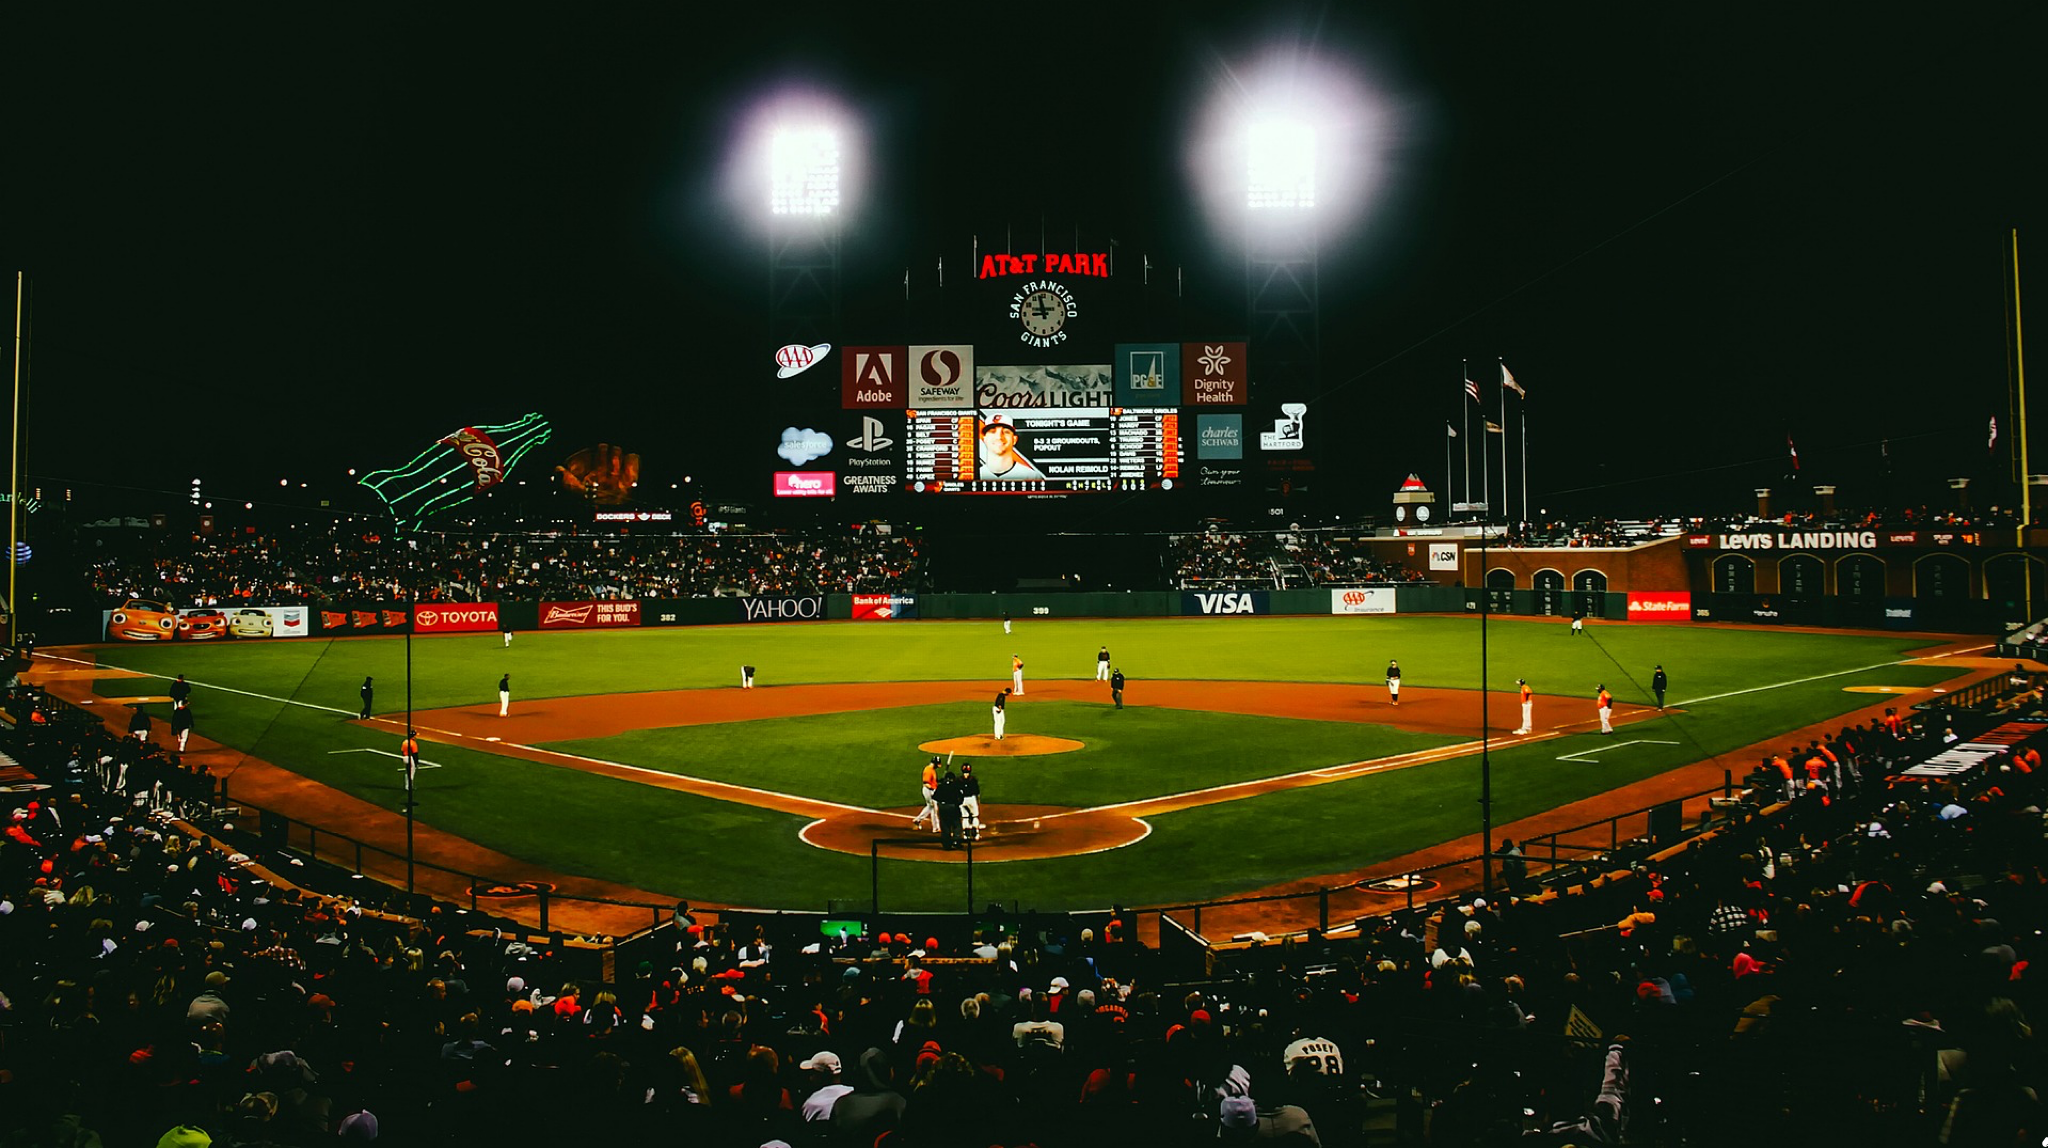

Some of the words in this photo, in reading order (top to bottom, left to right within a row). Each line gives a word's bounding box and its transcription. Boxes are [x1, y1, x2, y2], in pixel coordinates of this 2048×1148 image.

[979, 254, 1038, 279] AT&T
[1045, 253, 1108, 278] PARK
[1009, 292, 1025, 319] SAN
[1022, 280, 1078, 318] FRANCISCO
[1020, 330, 1067, 348] GIANTS
[778, 345, 812, 368] AAA
[1132, 374, 1163, 388] PG&E
[1194, 379, 1235, 392] Dignity
[856, 390, 893, 402] Adobe
[920, 387, 960, 395] SAFEWAY
[978, 383, 1048, 408] Coors
[1050, 391, 1113, 408] LIGHT
[1196, 392, 1233, 403] Health
[1025, 420, 1066, 428] TONIGHT'S
[1201, 426, 1239, 438] charles
[784, 439, 827, 449] salesforce
[1201, 439, 1239, 447] SCHWAB
[463, 443, 502, 487] Cola
[848, 458, 891, 468] PlayStation
[843, 475, 897, 485] GREATNESS
[1220, 469, 1240, 479] your
[852, 485, 888, 494] AWAITS
[1778, 532, 1877, 549] LANDING
[1440, 552, 1456, 561] CSN
[854, 597, 874, 605] Bank
[1194, 593, 1254, 614] VISA
[1342, 591, 1365, 606] AAA
[597, 604, 614, 613] THIS
[615, 603, 638, 613] BUD'S
[742, 597, 823, 621] YAHOO!
[440, 611, 498, 623] TOYOTA
[549, 610, 590, 619] Budweiser
[597, 614, 612, 623] FOR
[613, 613, 630, 622] YOU.
[1301, 1043, 1334, 1055] POSEY
